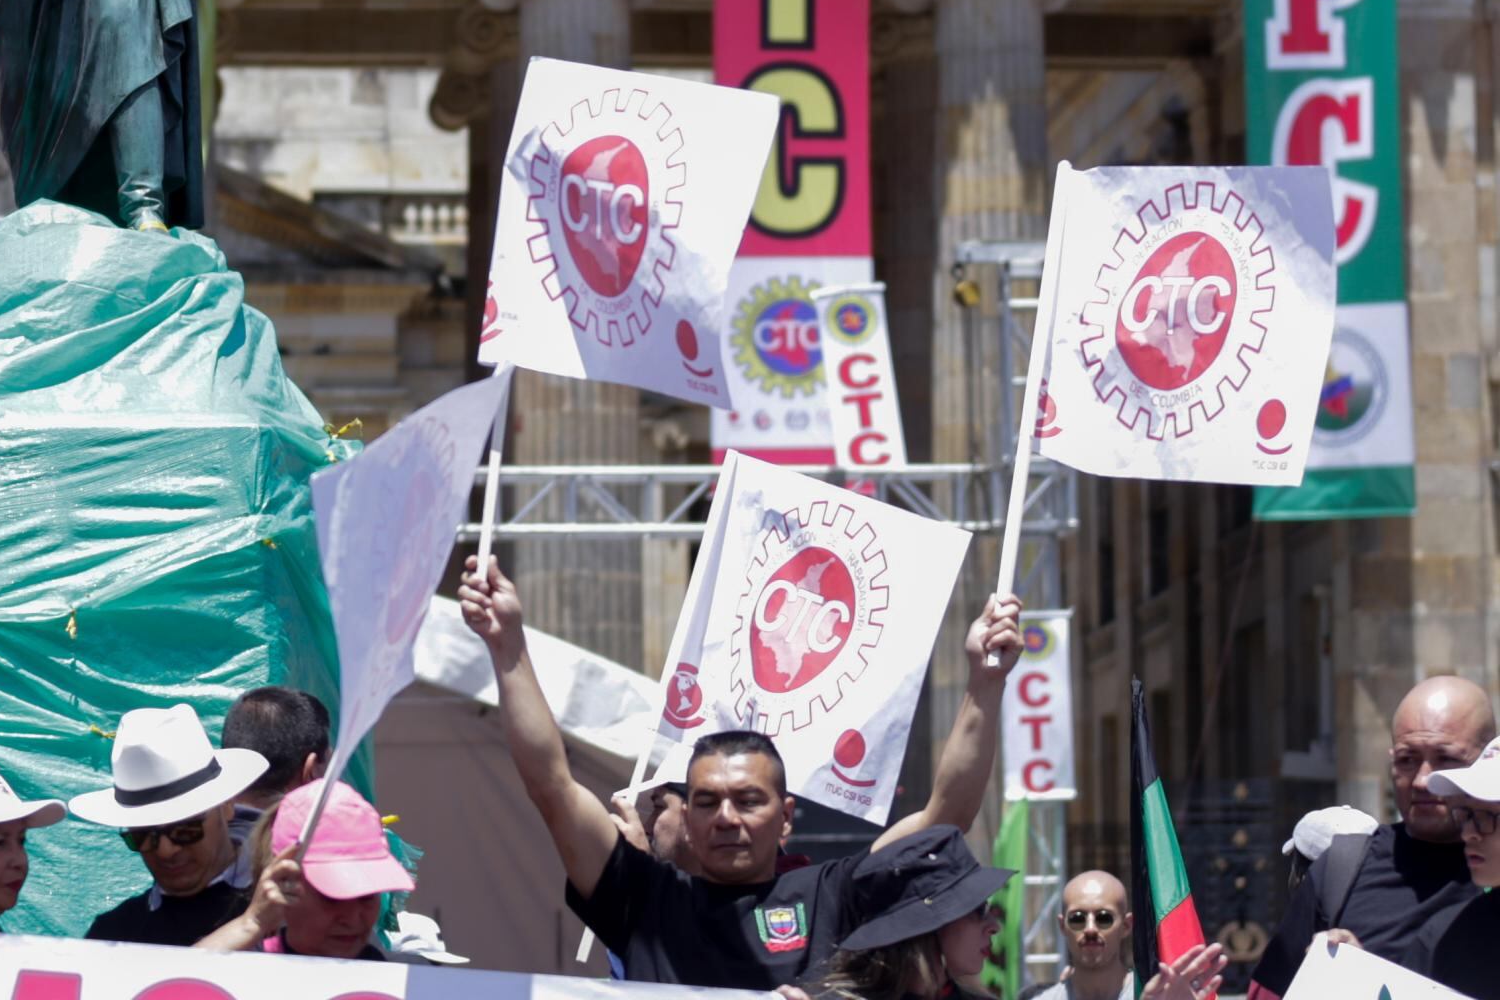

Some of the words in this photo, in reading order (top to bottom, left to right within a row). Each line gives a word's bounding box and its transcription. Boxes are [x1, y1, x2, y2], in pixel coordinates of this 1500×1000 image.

[561, 173, 644, 245] CTC
[1120, 275, 1232, 334] CTC
[838, 353, 891, 465] CTC
[754, 579, 850, 654] CTC
[1017, 672, 1055, 793] CTC
